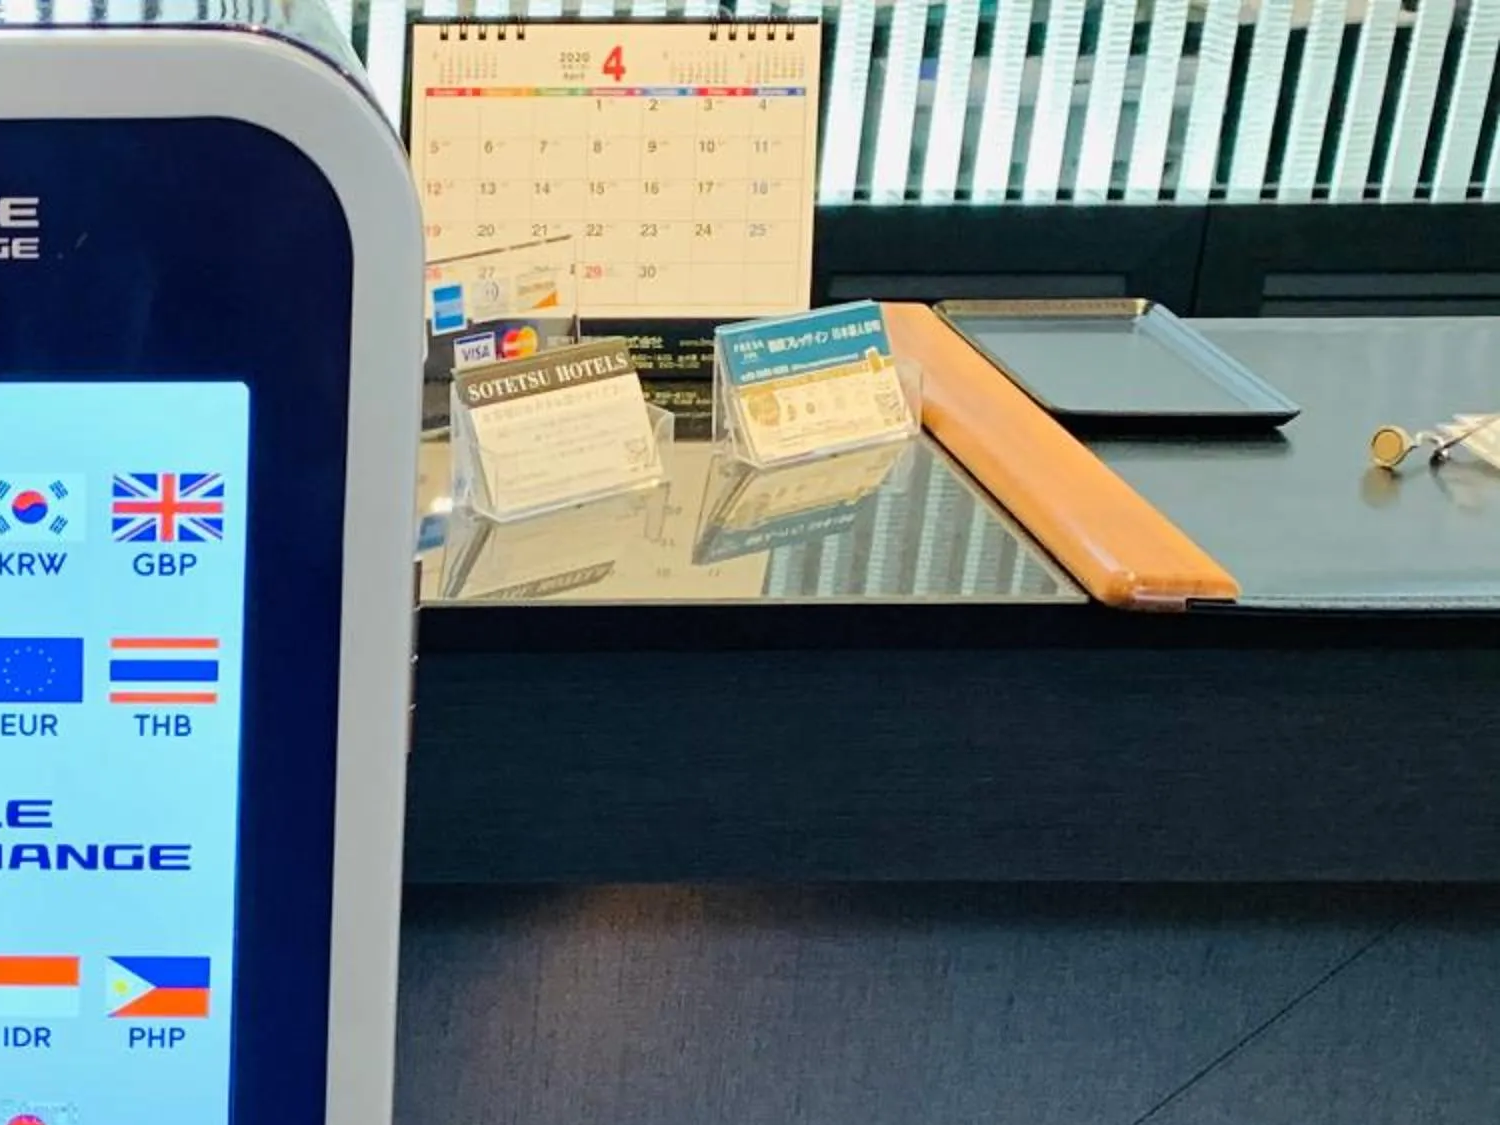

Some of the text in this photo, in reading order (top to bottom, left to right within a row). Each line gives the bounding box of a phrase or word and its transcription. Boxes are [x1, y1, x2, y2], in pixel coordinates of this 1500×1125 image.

[560, 52, 591, 63] 2020
[602, 46, 626, 81] 4
[596, 99, 767, 111] 1 2 3 4
[430, 141, 768, 154] 5 6 7 8 9 10 11
[426, 183, 442, 195] 12
[481, 183, 496, 195] 13
[534, 183, 550, 195] 14
[589, 183, 605, 195] 15
[644, 183, 659, 195] 16
[698, 183, 713, 195] 17
[426, 225, 766, 237] 19 20 21 22 23 24 25
[479, 266, 495, 278] 27
[585, 266, 603, 278] 29
[639, 266, 657, 278] 30
[461, 345, 490, 361] VISA
[467, 352, 628, 402] SOTETSU HOTELS
[133, 553, 197, 577] GBP
[0, 713, 58, 737] EUR
[134, 713, 192, 737] THB
[3, 1026, 51, 1049] IDR
[129, 1027, 186, 1049] PHP
